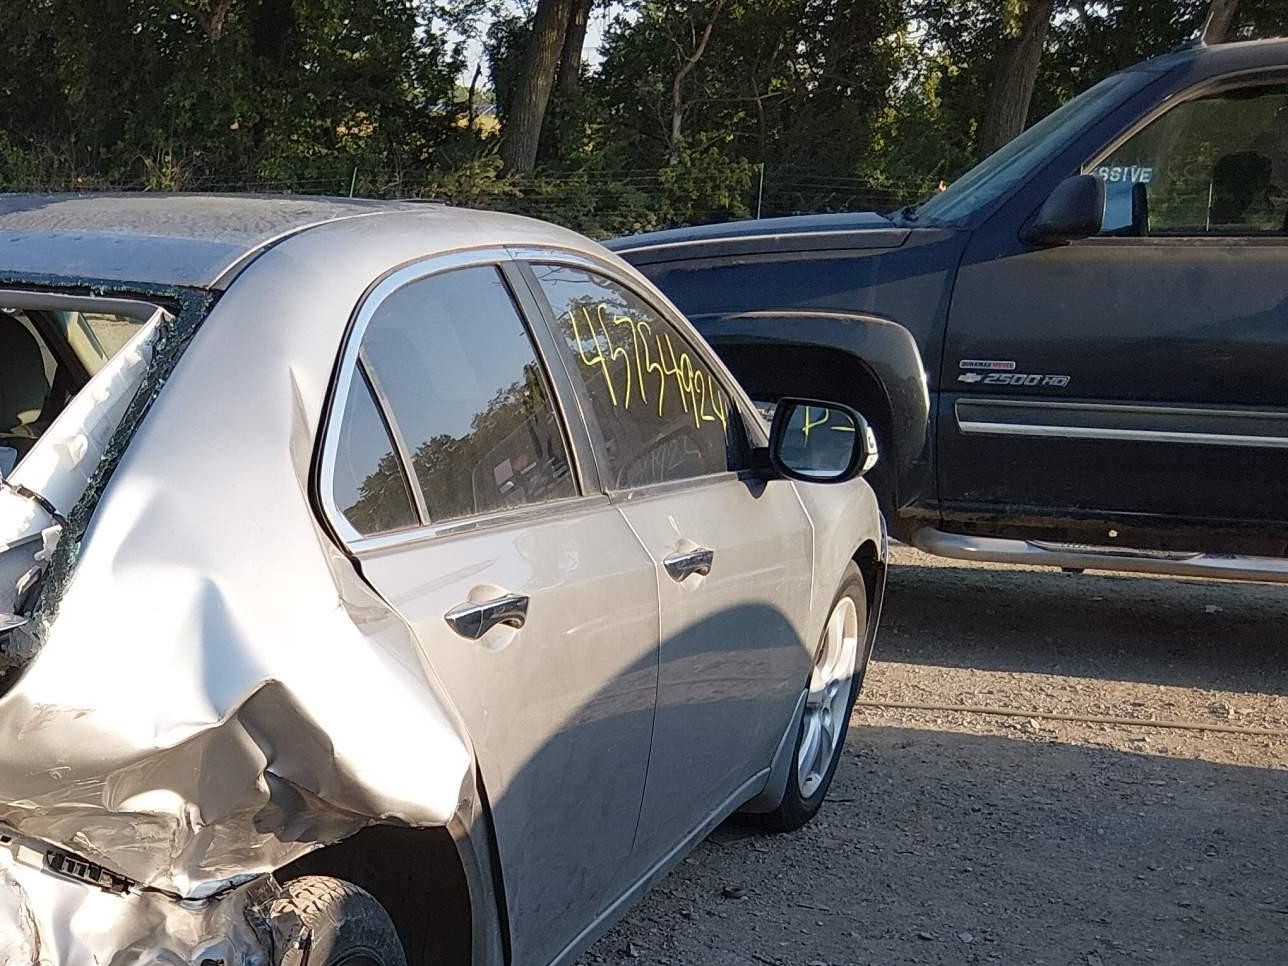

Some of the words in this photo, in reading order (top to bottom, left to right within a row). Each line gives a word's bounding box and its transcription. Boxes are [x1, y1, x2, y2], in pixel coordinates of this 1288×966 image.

[1095, 166, 1153, 183] SSIVE
[568, 303, 728, 433] 45754924
[983, 373, 1043, 386] 2500
[1041, 375, 1071, 387] HD
